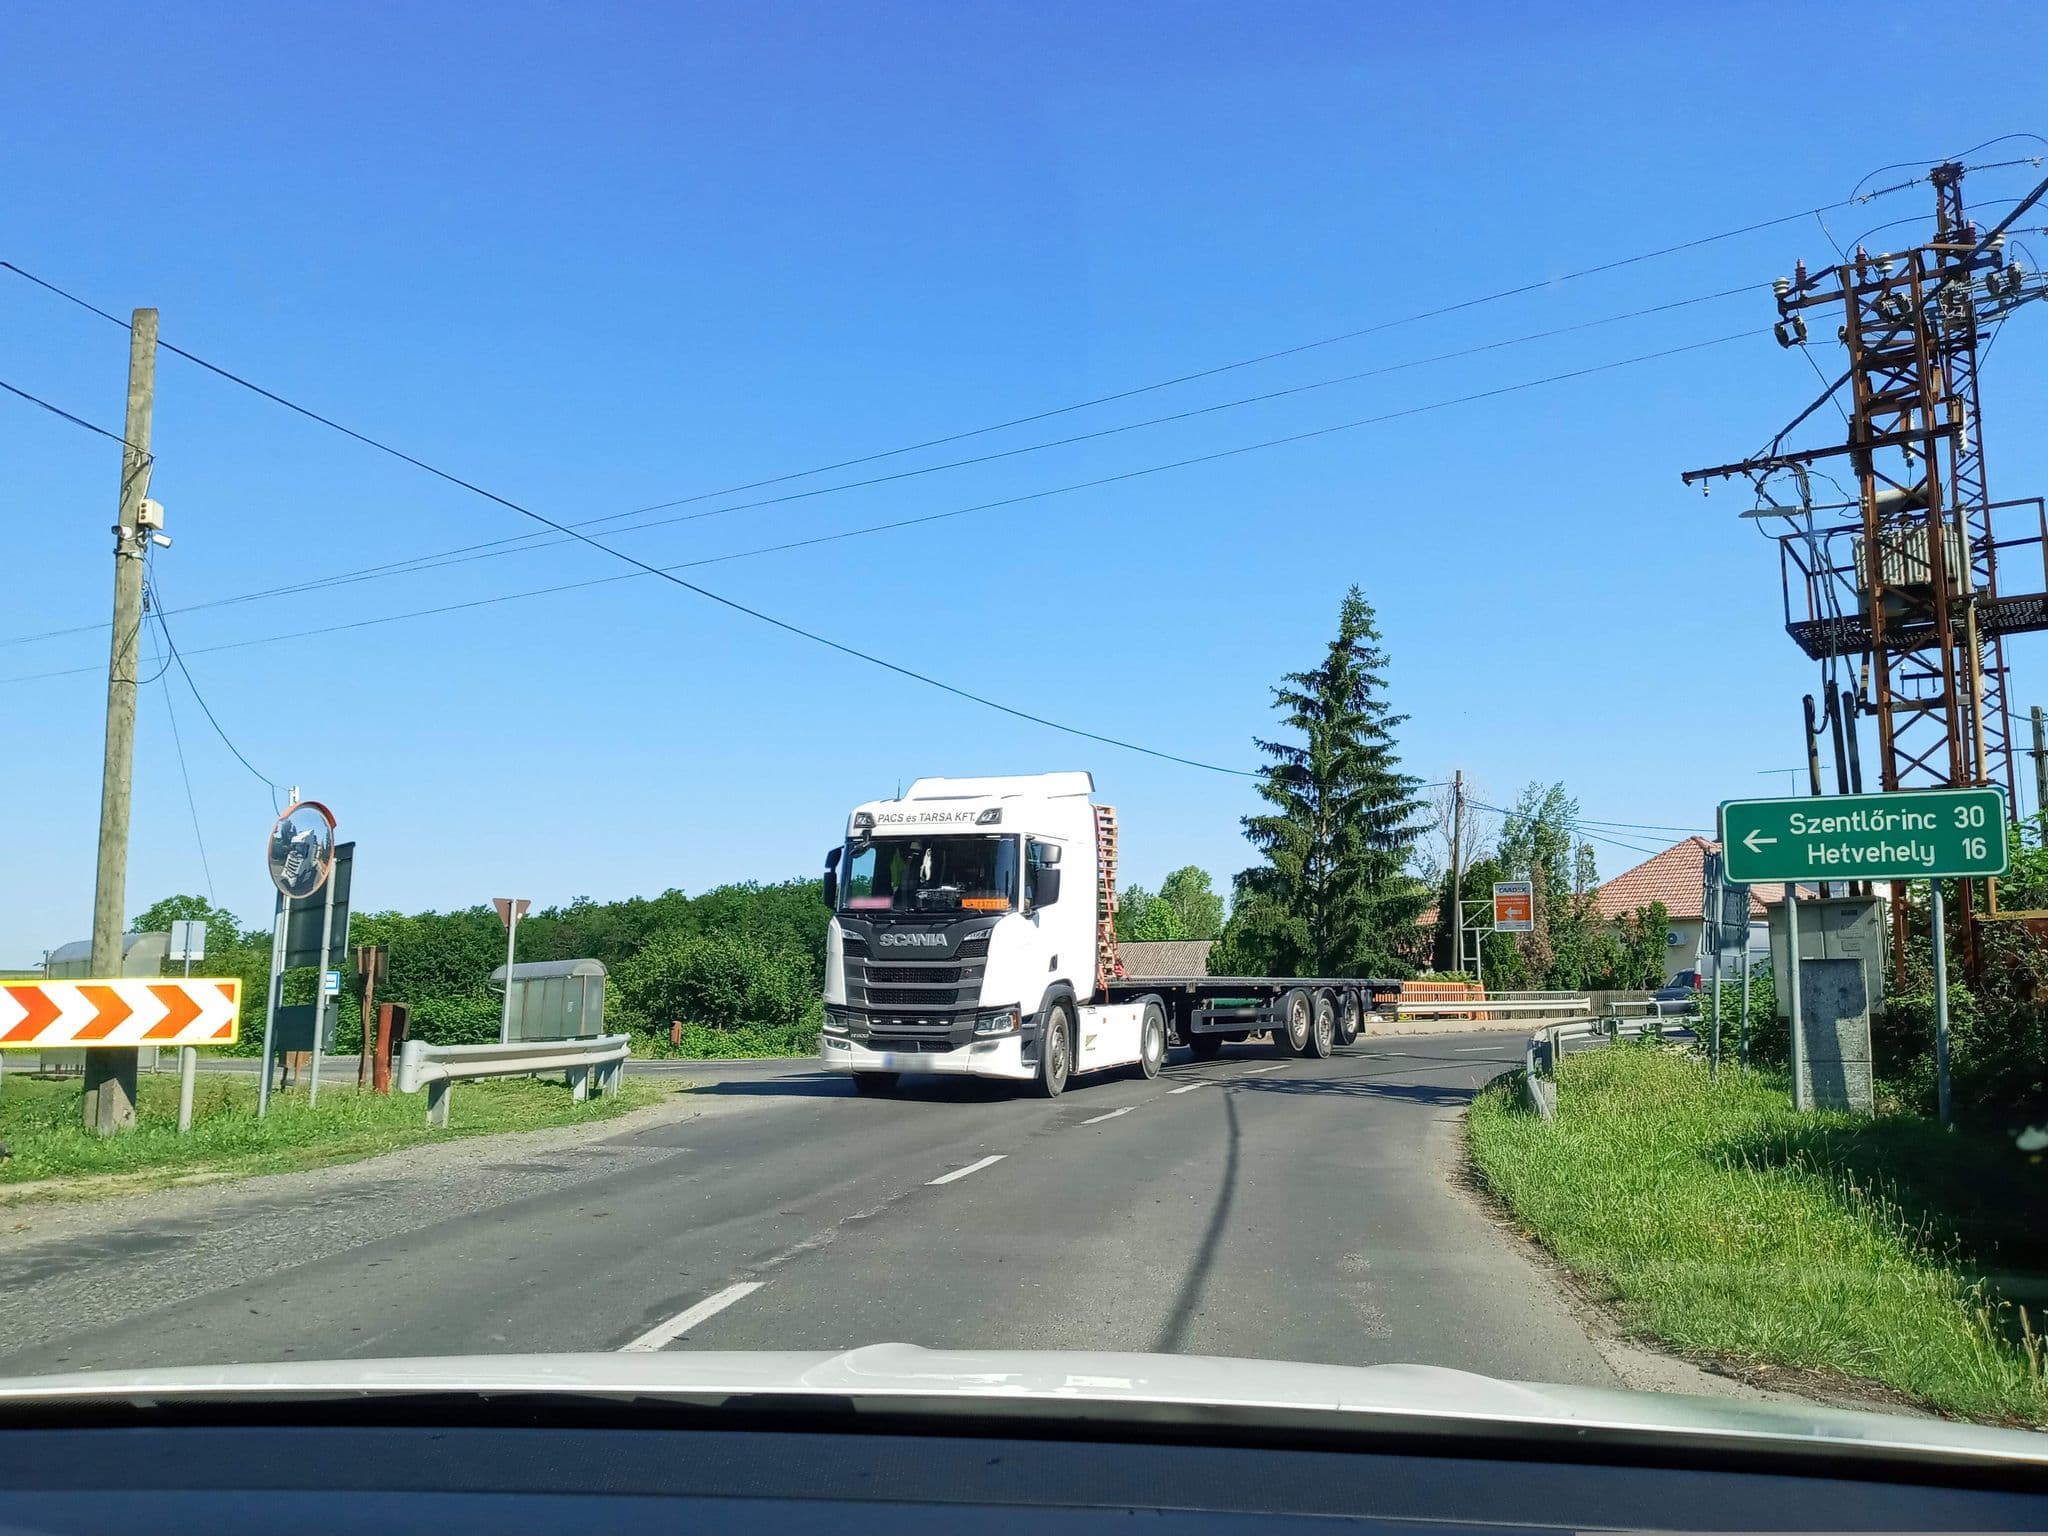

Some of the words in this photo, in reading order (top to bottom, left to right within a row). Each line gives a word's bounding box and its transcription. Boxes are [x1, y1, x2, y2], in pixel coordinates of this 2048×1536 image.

[877, 813, 904, 823] PACS
[919, 812, 953, 823] TARSA
[1789, 808, 1937, 835] Szentlőrinc
[1953, 805, 1985, 829] 30
[1807, 840, 1936, 867] Hetvehely
[1962, 837, 1987, 860] 16
[879, 933, 948, 947] SCANIA
